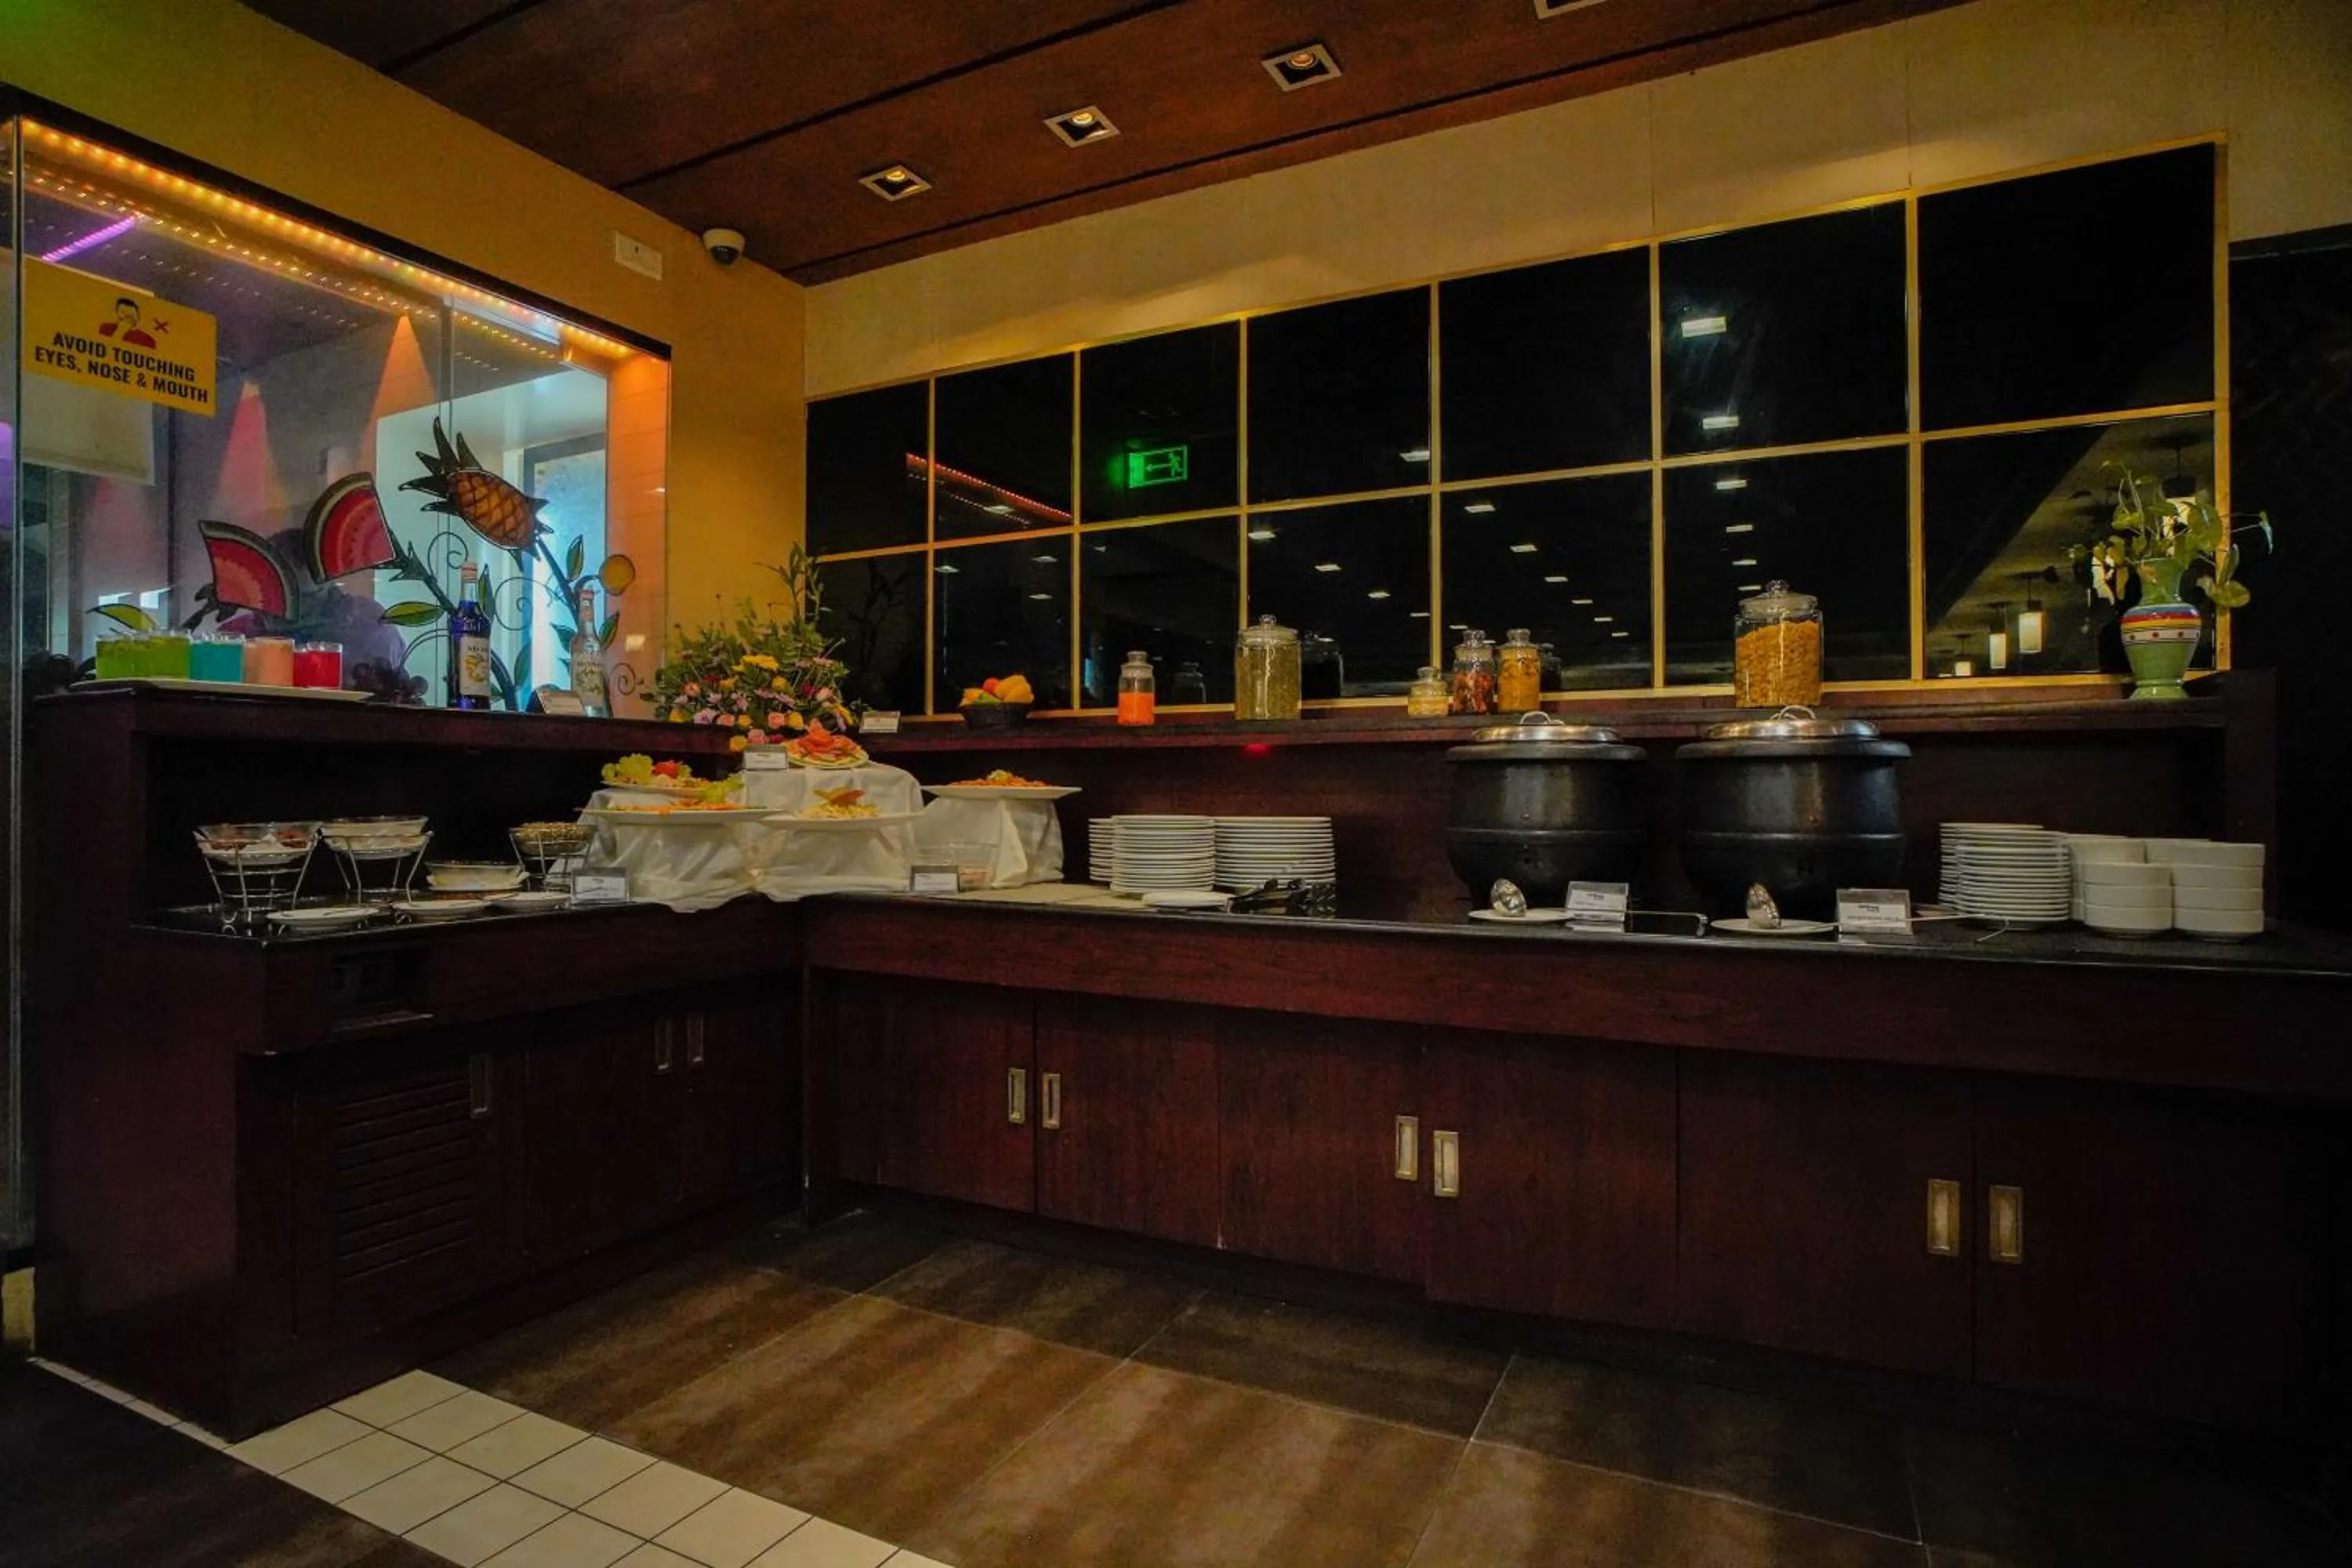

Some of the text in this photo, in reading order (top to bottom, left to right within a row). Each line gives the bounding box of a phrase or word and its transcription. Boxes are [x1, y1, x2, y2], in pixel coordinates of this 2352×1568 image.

[34, 346, 208, 403] EYES, NOSE & MOUTH
[53, 332, 194, 381] AVOID TOUCHING
